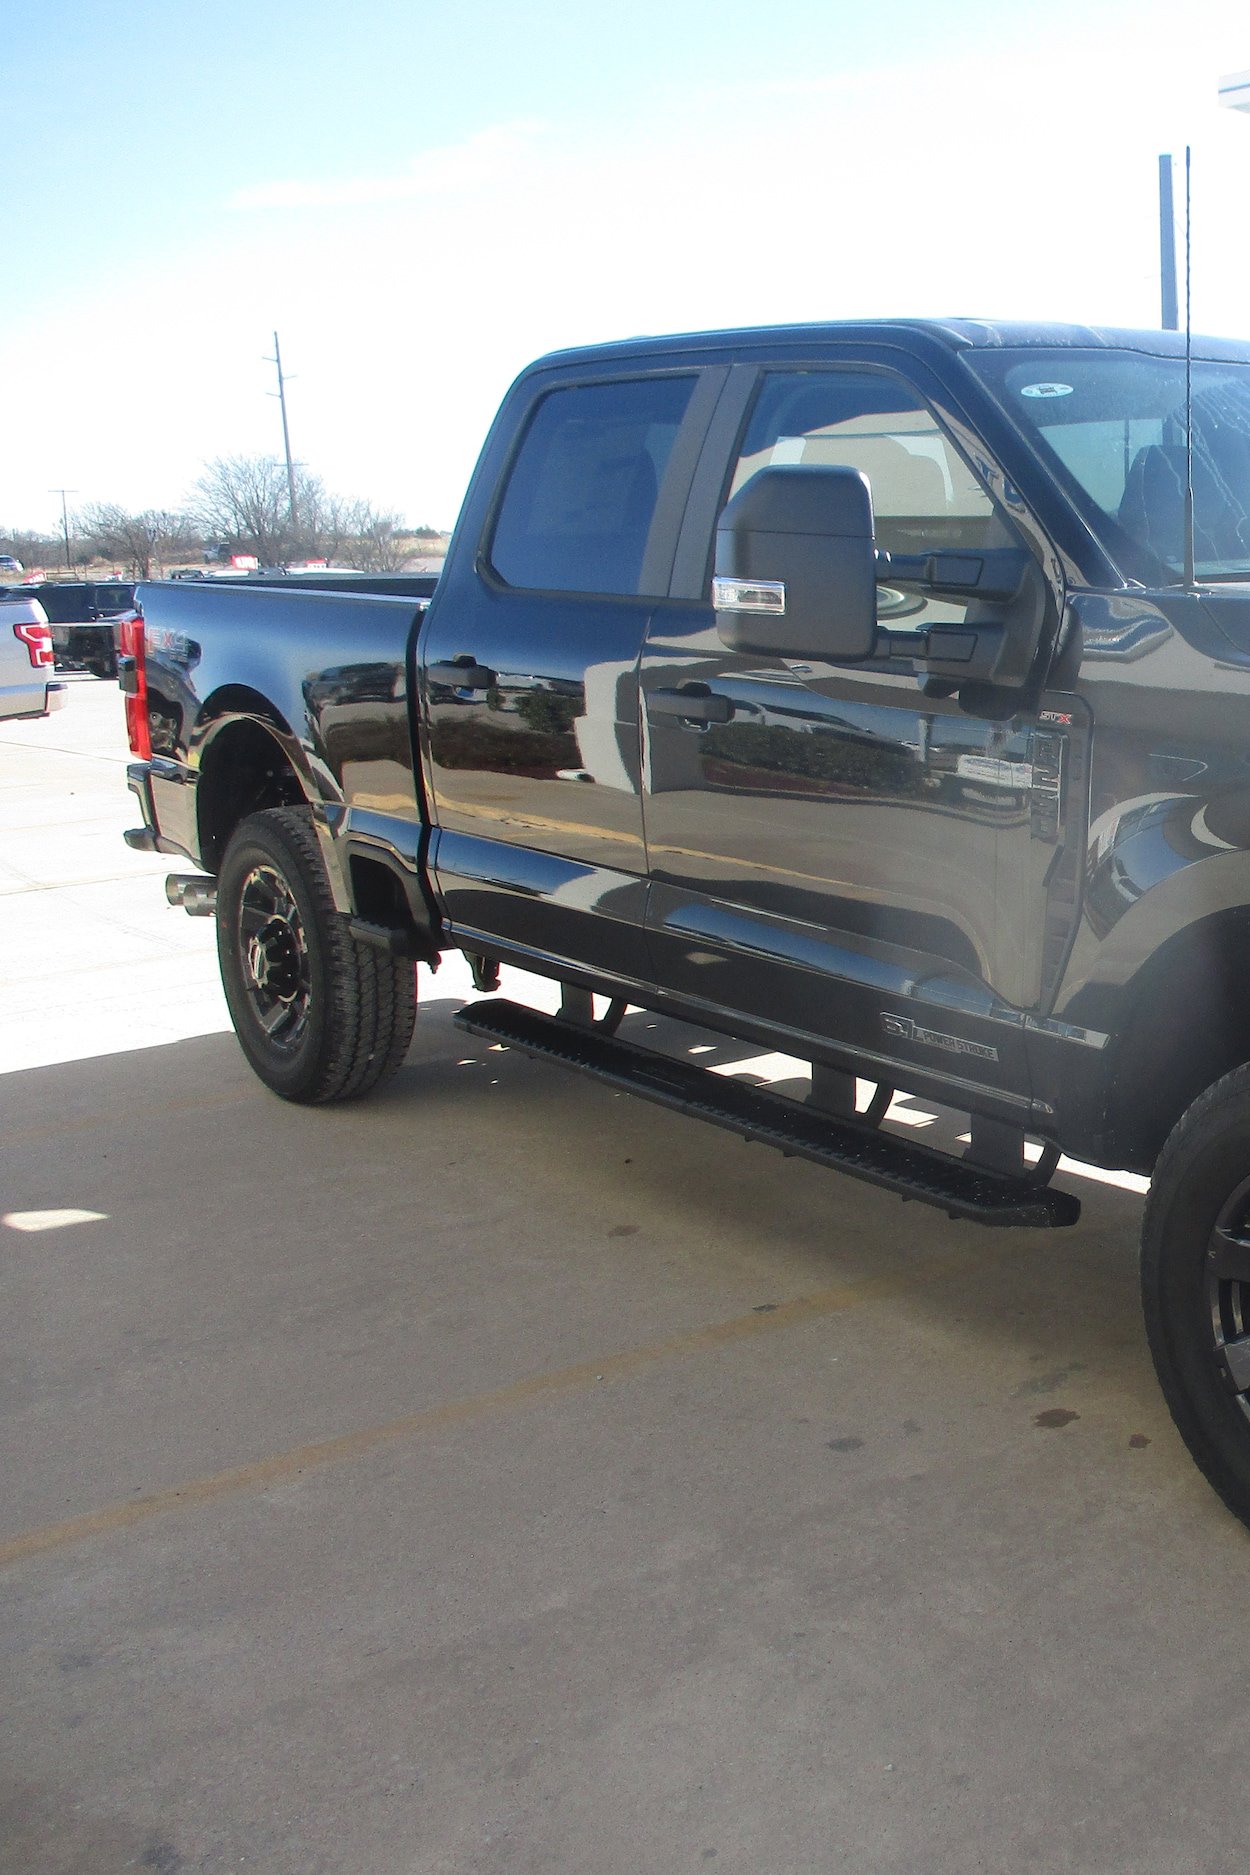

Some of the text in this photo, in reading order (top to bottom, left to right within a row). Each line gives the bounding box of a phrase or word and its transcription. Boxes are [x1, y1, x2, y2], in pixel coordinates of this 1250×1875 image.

[1039, 710, 1073, 725] STX
[922, 1031, 995, 1058] POWER STROKE
